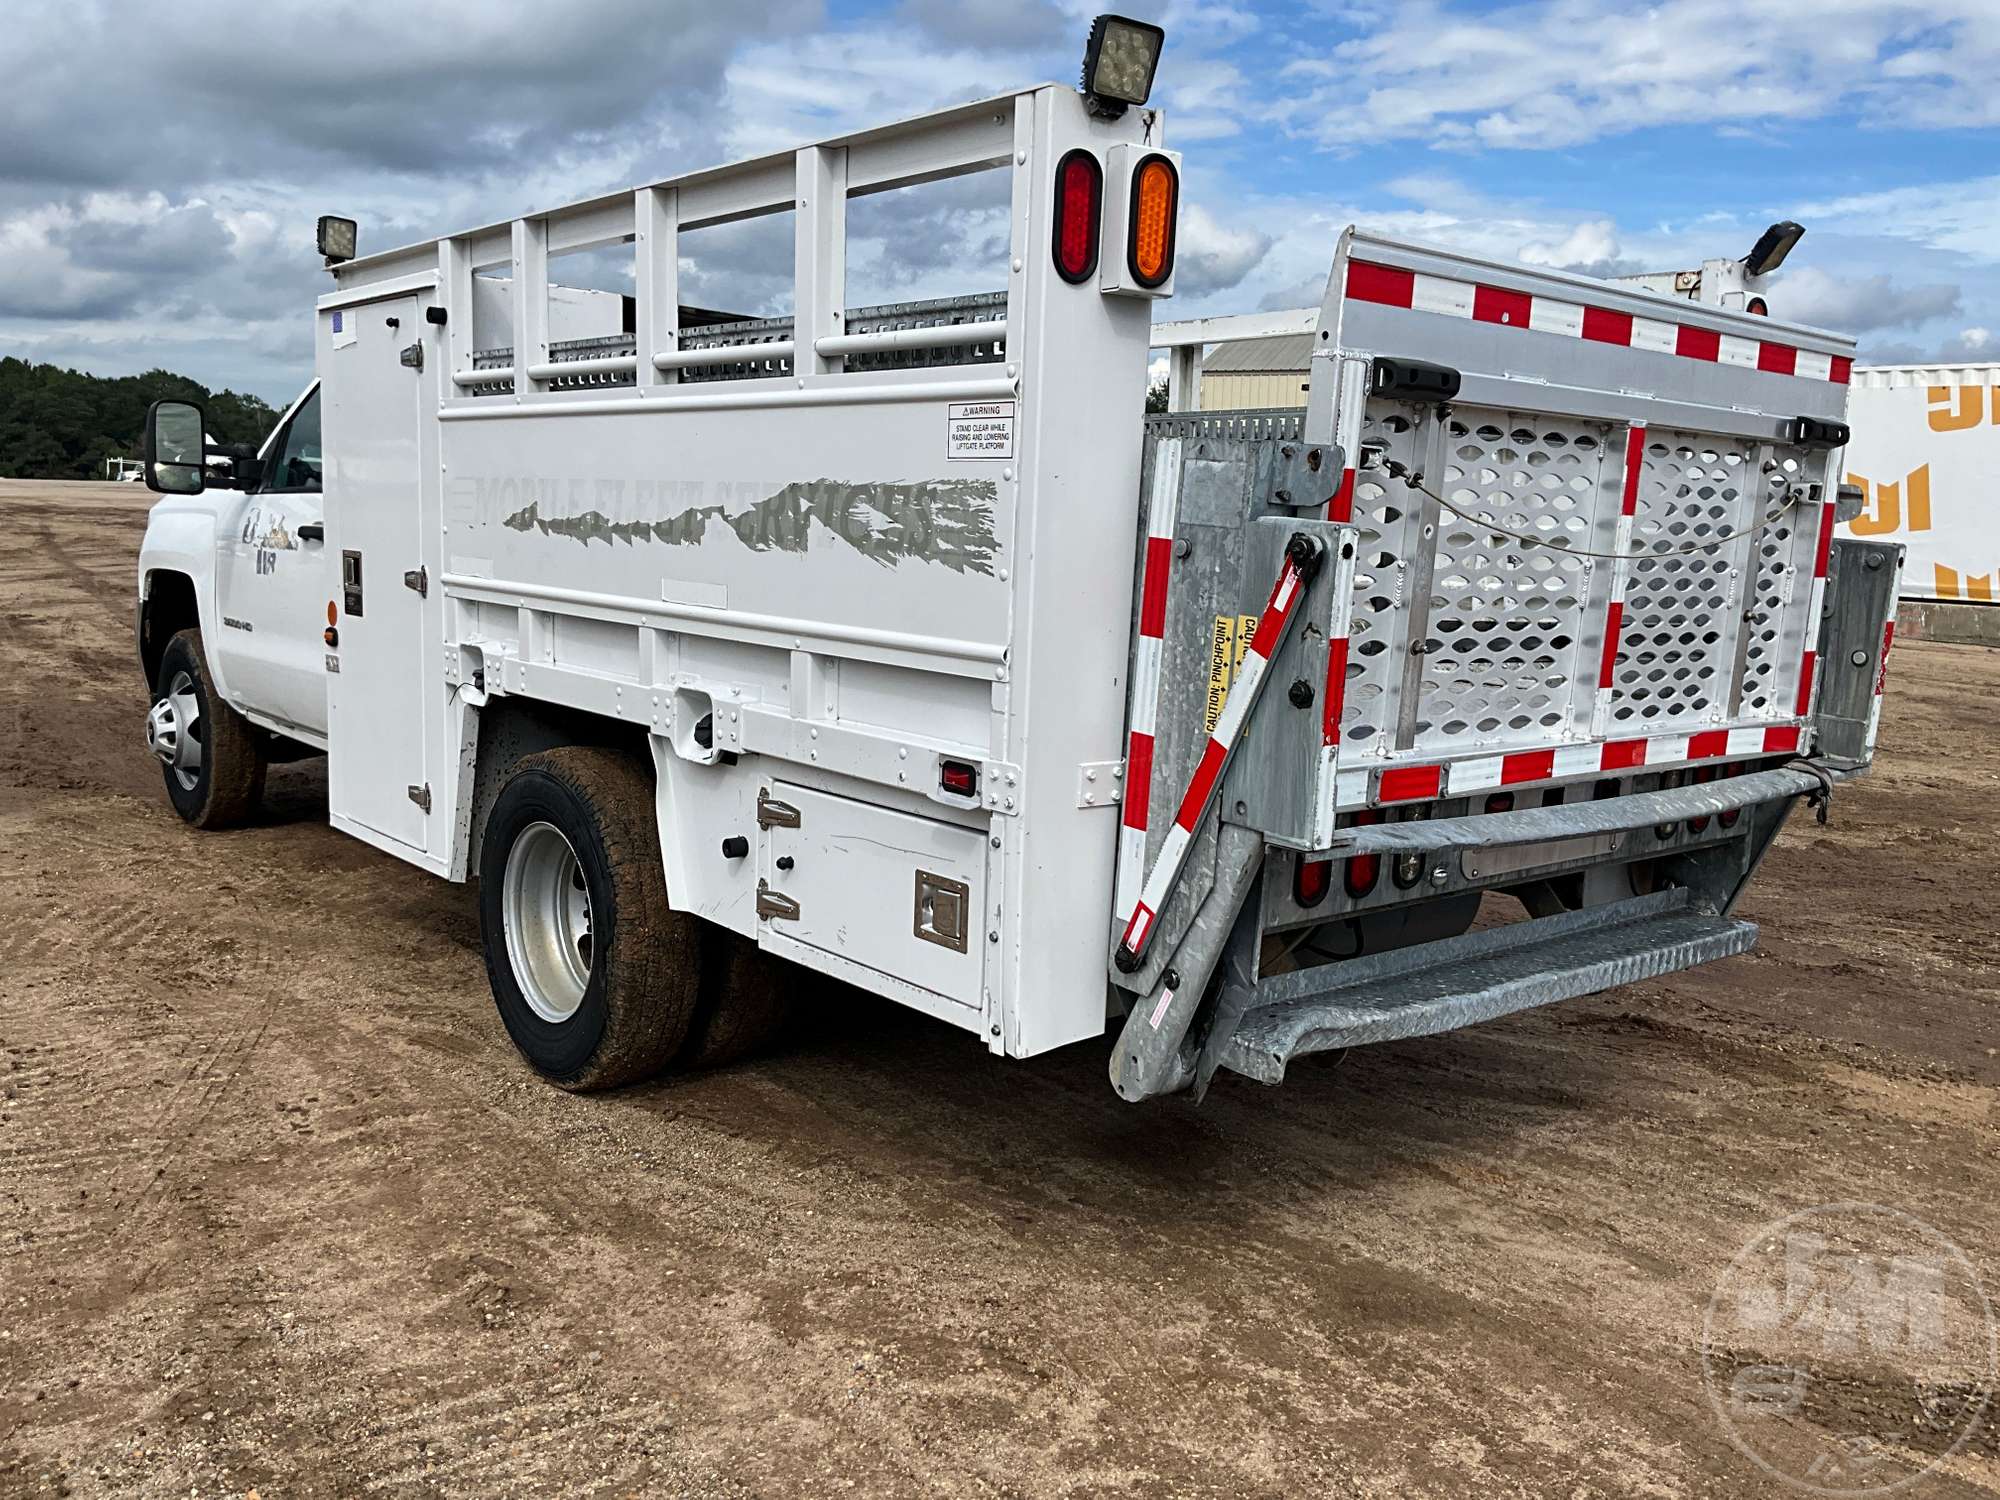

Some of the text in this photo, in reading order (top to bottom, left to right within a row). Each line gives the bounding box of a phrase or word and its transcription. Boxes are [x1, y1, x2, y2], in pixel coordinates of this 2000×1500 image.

[969, 405, 1001, 415] WARNING
[956, 423, 1006, 433] STAND CLEAR WHILE
[951, 432, 1010, 442] RAISING AND LOWERING
[979, 442, 1005, 450] PLATFORM
[1206, 619, 1227, 733] CAUTION: PINCHPOINT
